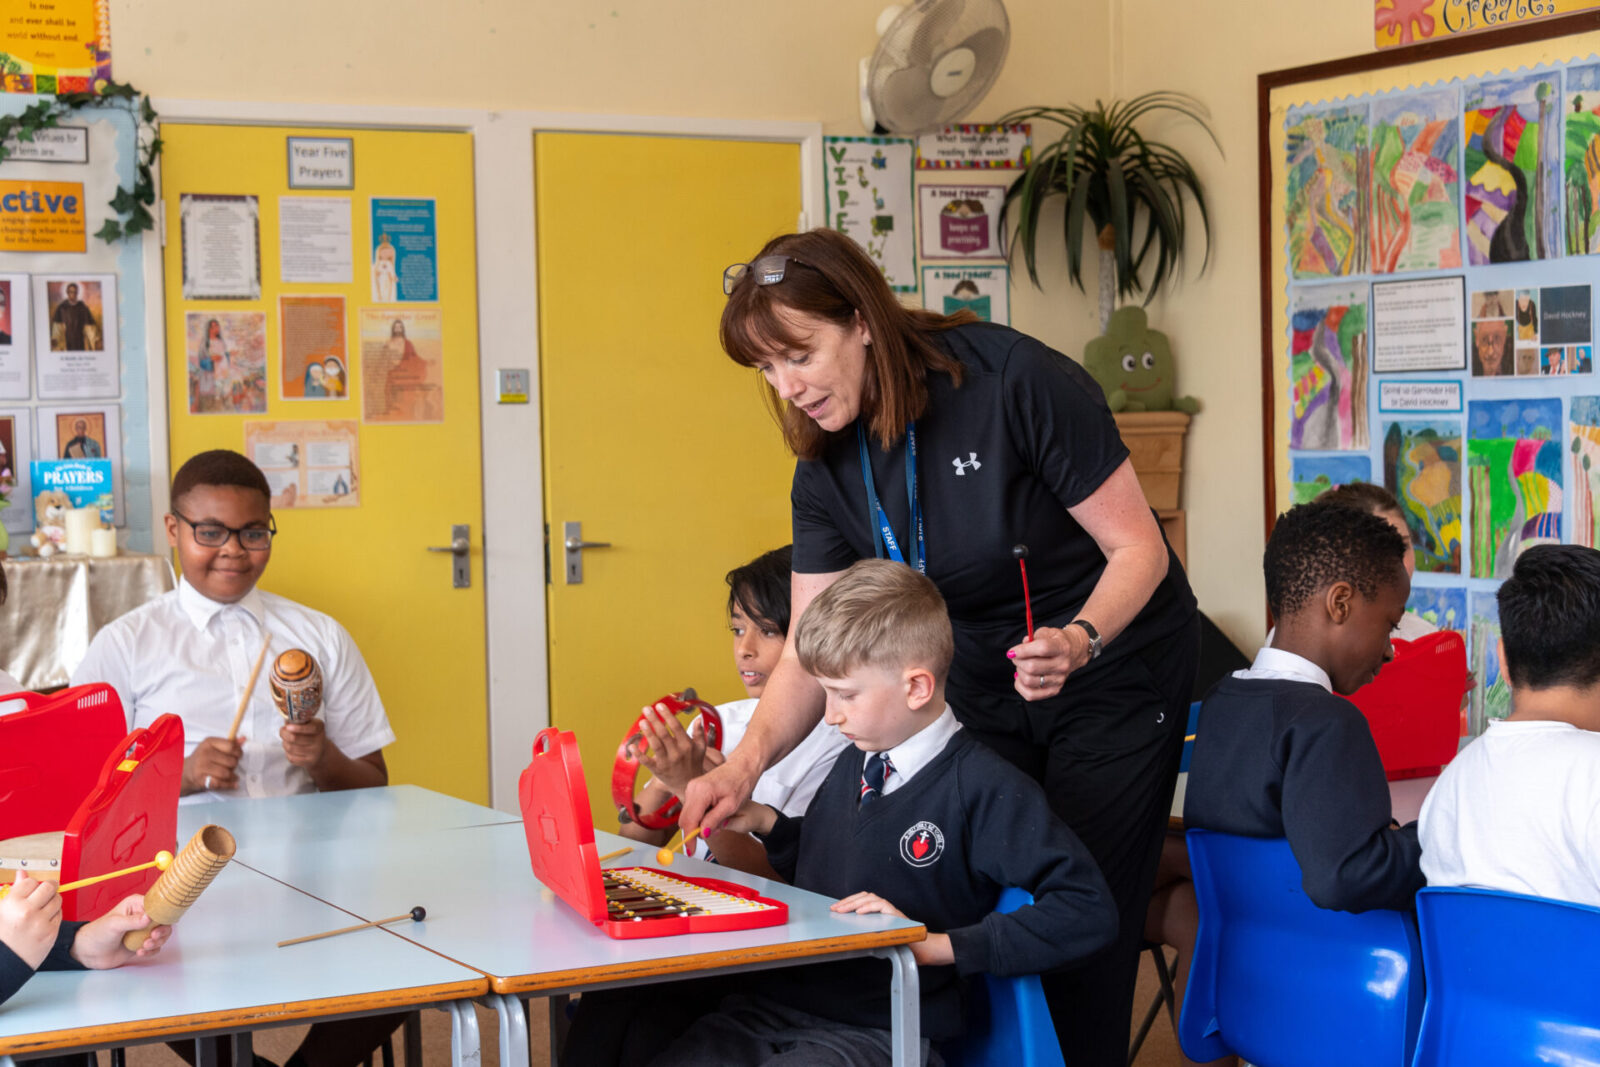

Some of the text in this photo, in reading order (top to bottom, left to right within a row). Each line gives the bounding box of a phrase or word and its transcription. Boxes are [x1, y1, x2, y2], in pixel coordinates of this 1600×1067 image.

[45, 17, 64, 26] shall
[30, 32, 61, 40] without
[936, 135, 957, 143] What
[960, 134, 977, 143] book
[996, 135, 1009, 145] you
[294, 146, 348, 159] Year Five
[937, 147, 1009, 159] reading this week?
[299, 166, 343, 180] Prayers
[0, 190, 77, 214] ctive
[1543, 311, 1587, 321] David Hockney
[1400, 398, 1418, 406] David
[1420, 398, 1449, 408] Hockney
[909, 430, 917, 456] STAFF
[44, 470, 104, 485] PRAYERS
[882, 526, 897, 551] STAFF
